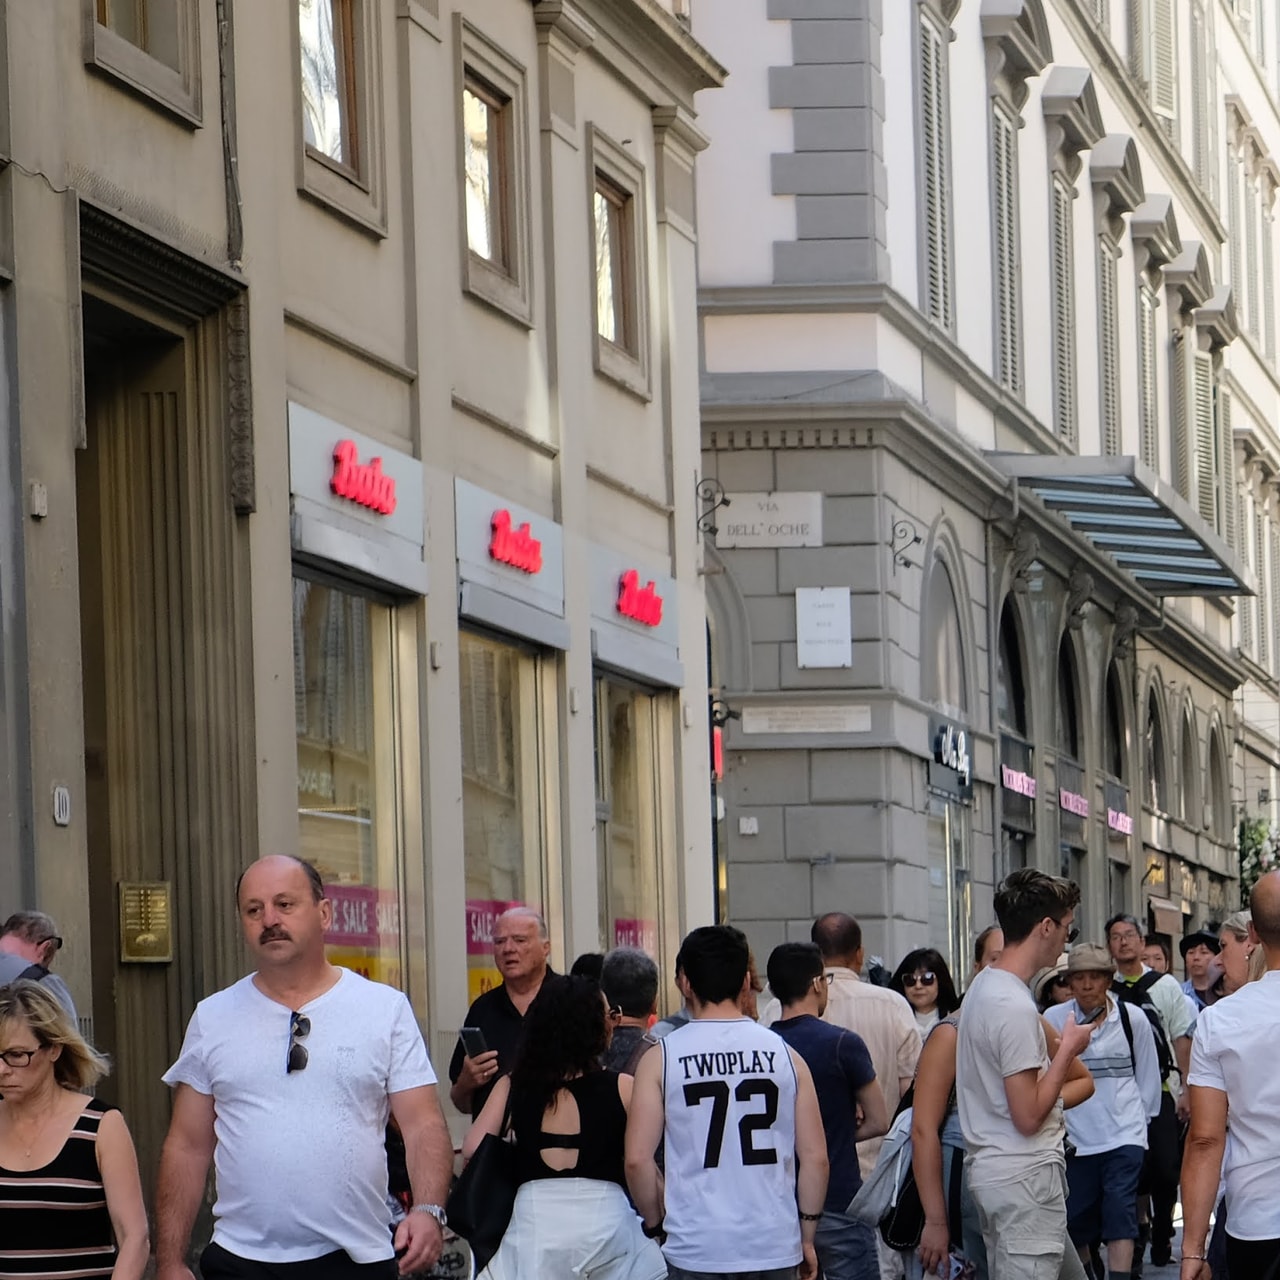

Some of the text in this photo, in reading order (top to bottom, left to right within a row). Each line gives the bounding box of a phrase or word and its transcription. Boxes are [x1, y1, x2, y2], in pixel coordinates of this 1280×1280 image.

[757, 502, 779, 511] VIA
[727, 523, 810, 536] DELL' OCHE
[342, 901, 369, 934] SALE
[471, 911, 494, 943] SALE
[678, 1050, 776, 1079] TWOPLAY
[682, 1078, 779, 1169] 72
